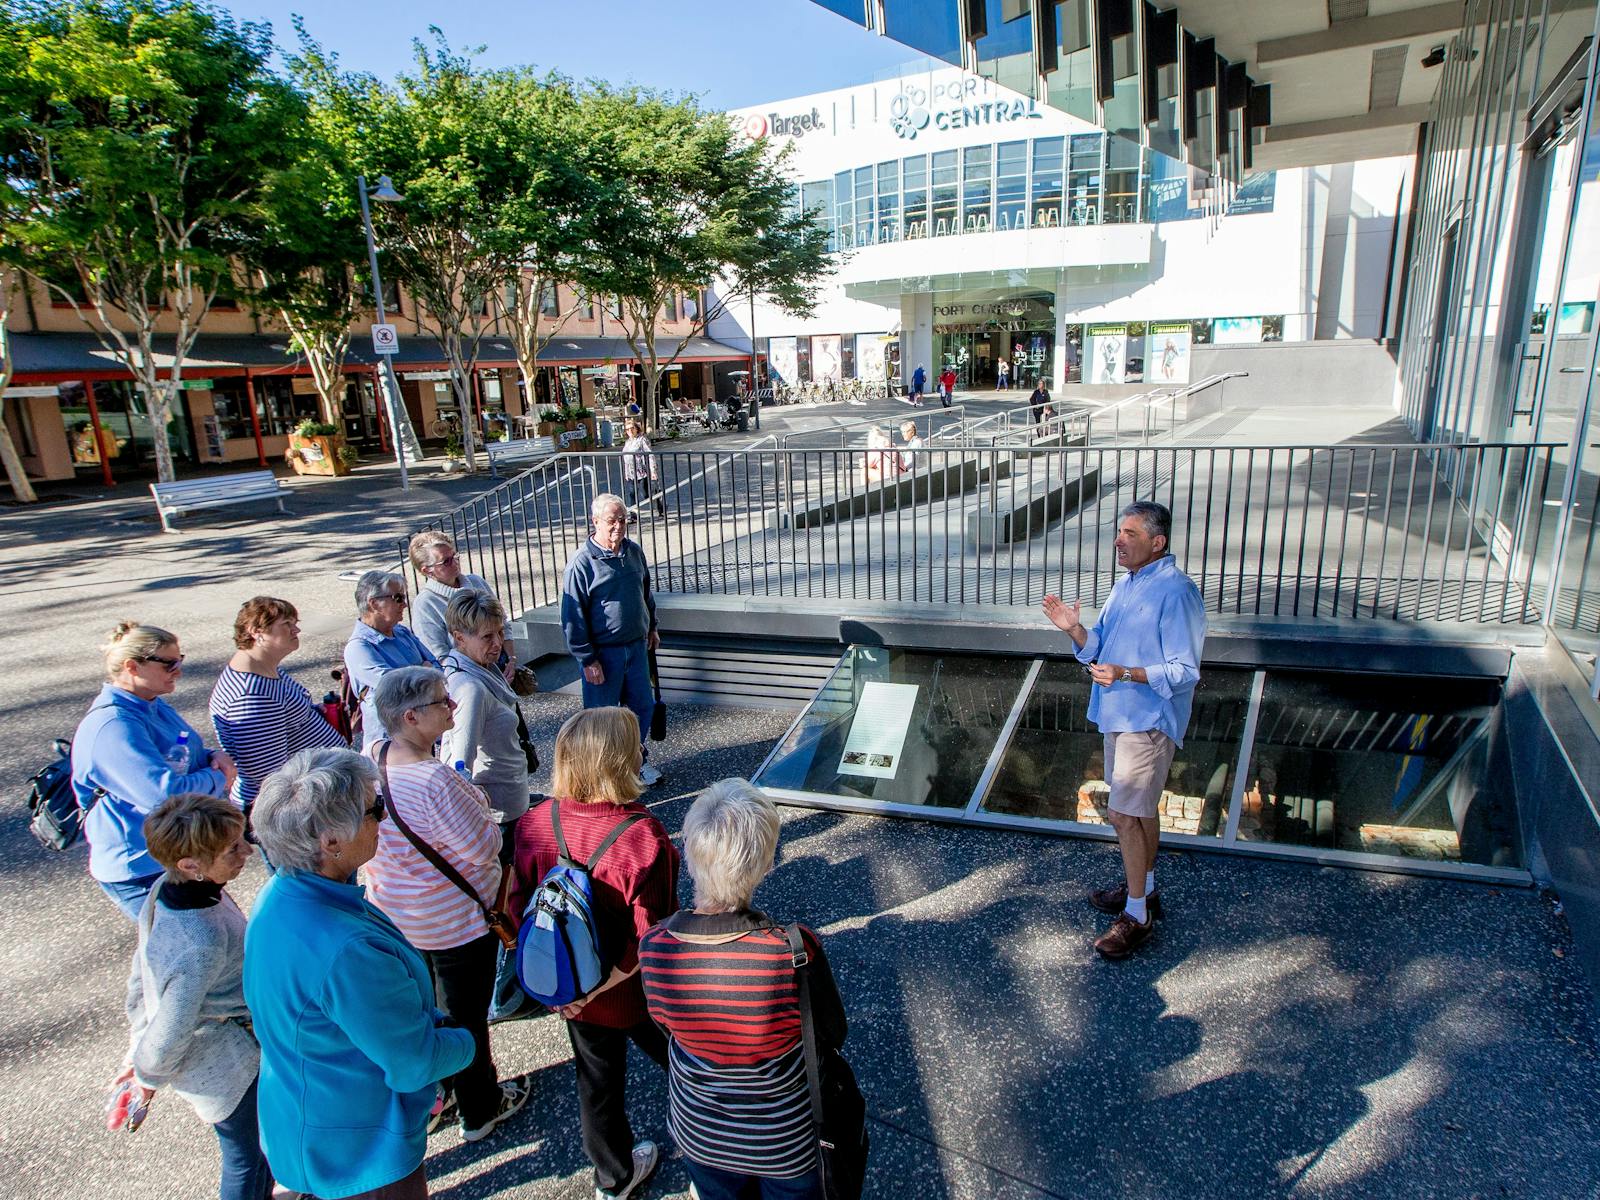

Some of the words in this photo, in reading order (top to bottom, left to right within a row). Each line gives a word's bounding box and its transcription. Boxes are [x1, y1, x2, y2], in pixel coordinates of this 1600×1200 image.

[934, 75, 992, 103] PORT
[768, 107, 826, 138] Target.
[936, 97, 1043, 131] CENTRAL
[933, 304, 966, 316] PORT
